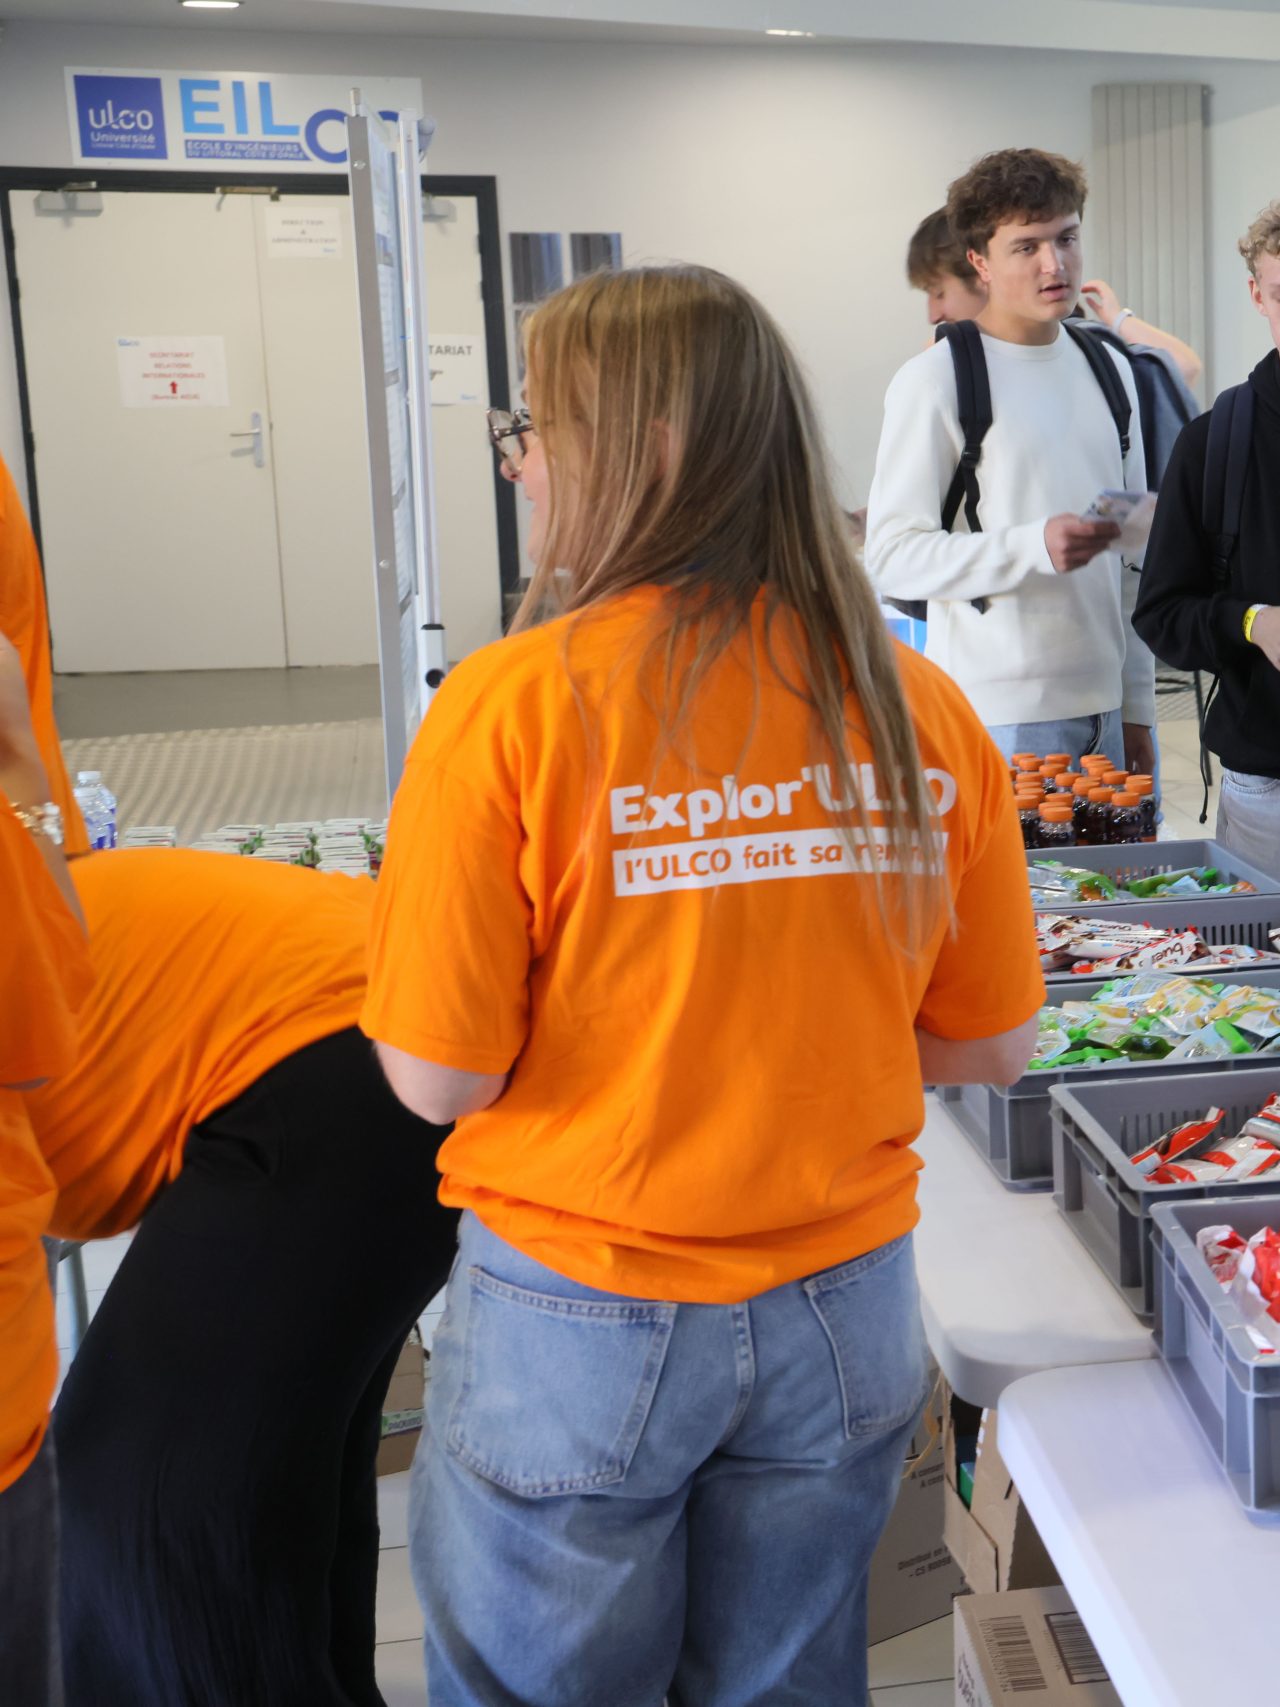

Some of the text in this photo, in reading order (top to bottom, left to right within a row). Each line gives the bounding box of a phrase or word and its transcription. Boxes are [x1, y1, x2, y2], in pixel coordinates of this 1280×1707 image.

[179, 79, 399, 163] EILC
[428, 344, 473, 355] TARIAT
[609, 763, 957, 838] Explor'ULO
[744, 842, 796, 870] fait
[810, 843, 843, 864] sa
